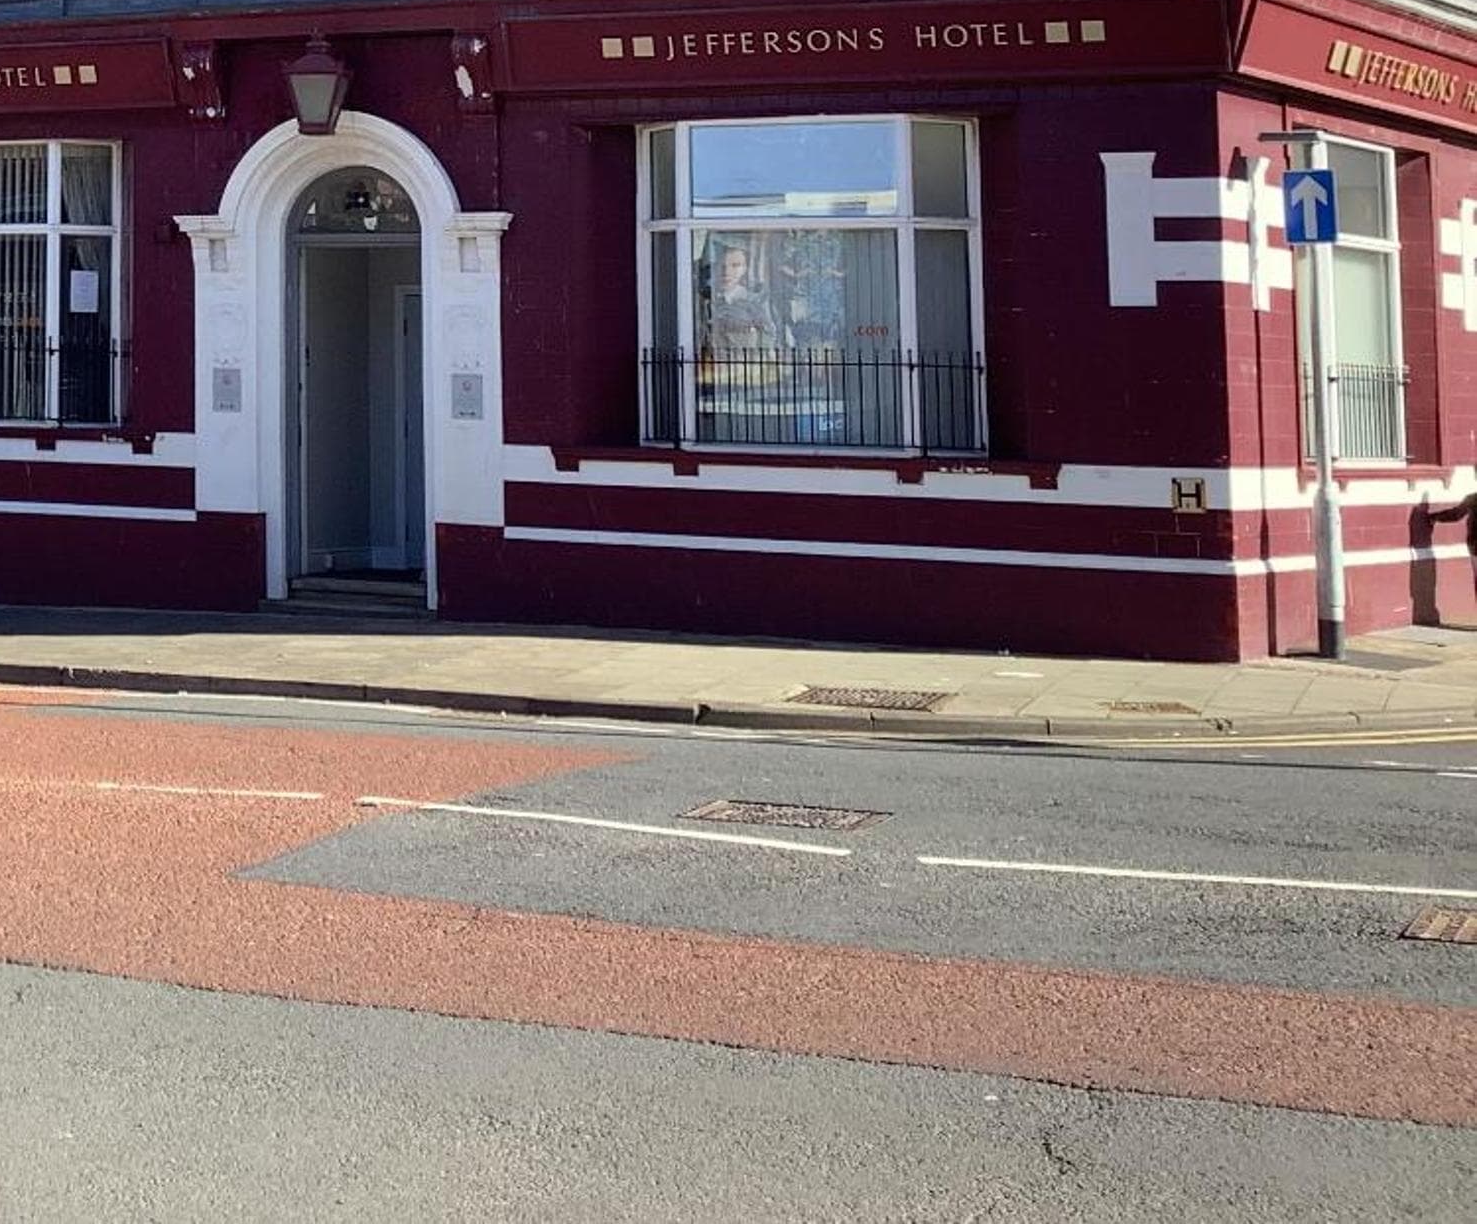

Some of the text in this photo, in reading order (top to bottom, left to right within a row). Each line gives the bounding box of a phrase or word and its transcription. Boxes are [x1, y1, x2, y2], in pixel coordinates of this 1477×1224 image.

[666, 22, 1034, 61] JEFFERSONS HOTEL
[1359, 49, 1460, 104] JEFFERSONS
[1176, 480, 1203, 509] H
